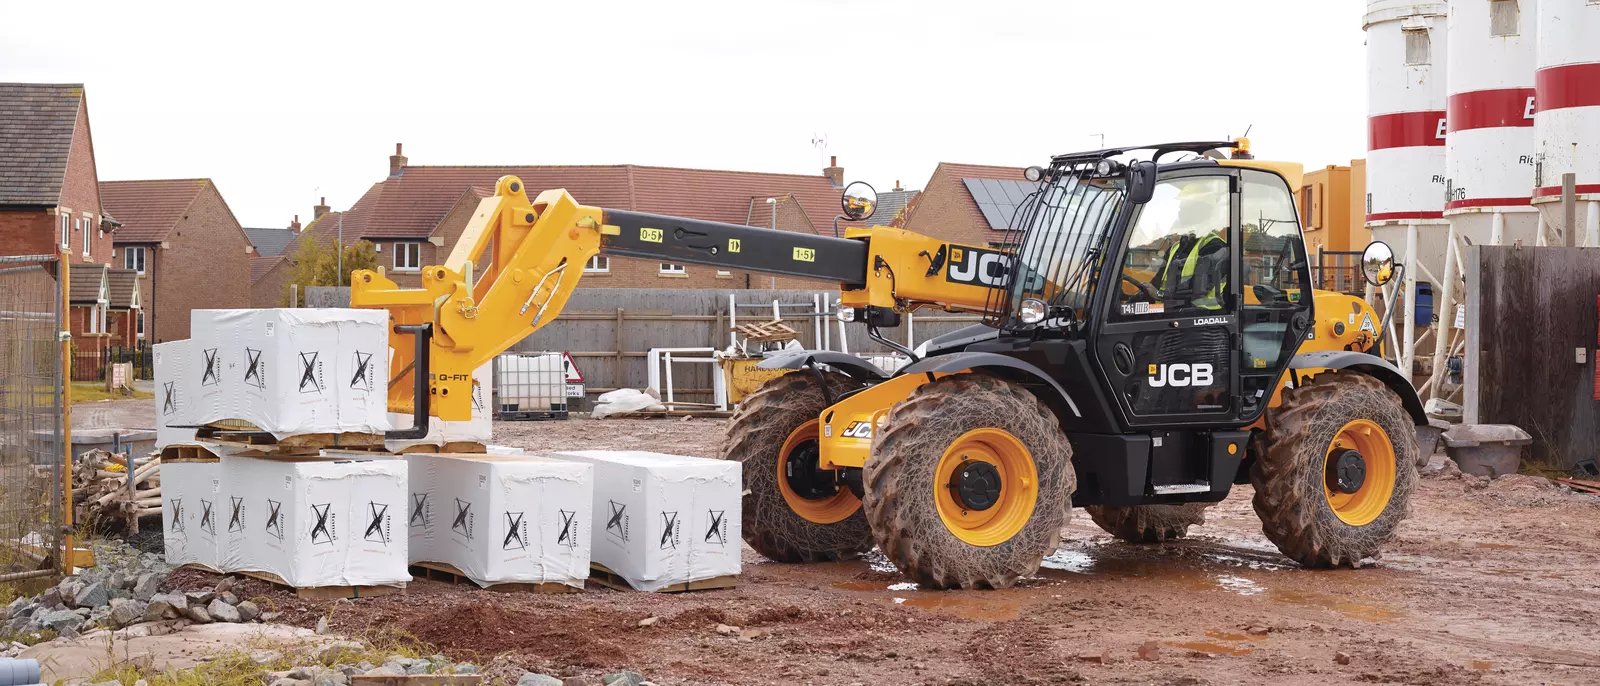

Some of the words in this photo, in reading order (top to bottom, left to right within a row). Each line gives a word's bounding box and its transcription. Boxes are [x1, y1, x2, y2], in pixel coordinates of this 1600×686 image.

[950, 250, 1012, 287] JC
[1193, 317, 1228, 326] LOADALL
[439, 374, 469, 382] Q-FIT
[1148, 363, 1214, 388] JCB
[843, 421, 872, 438] JC
